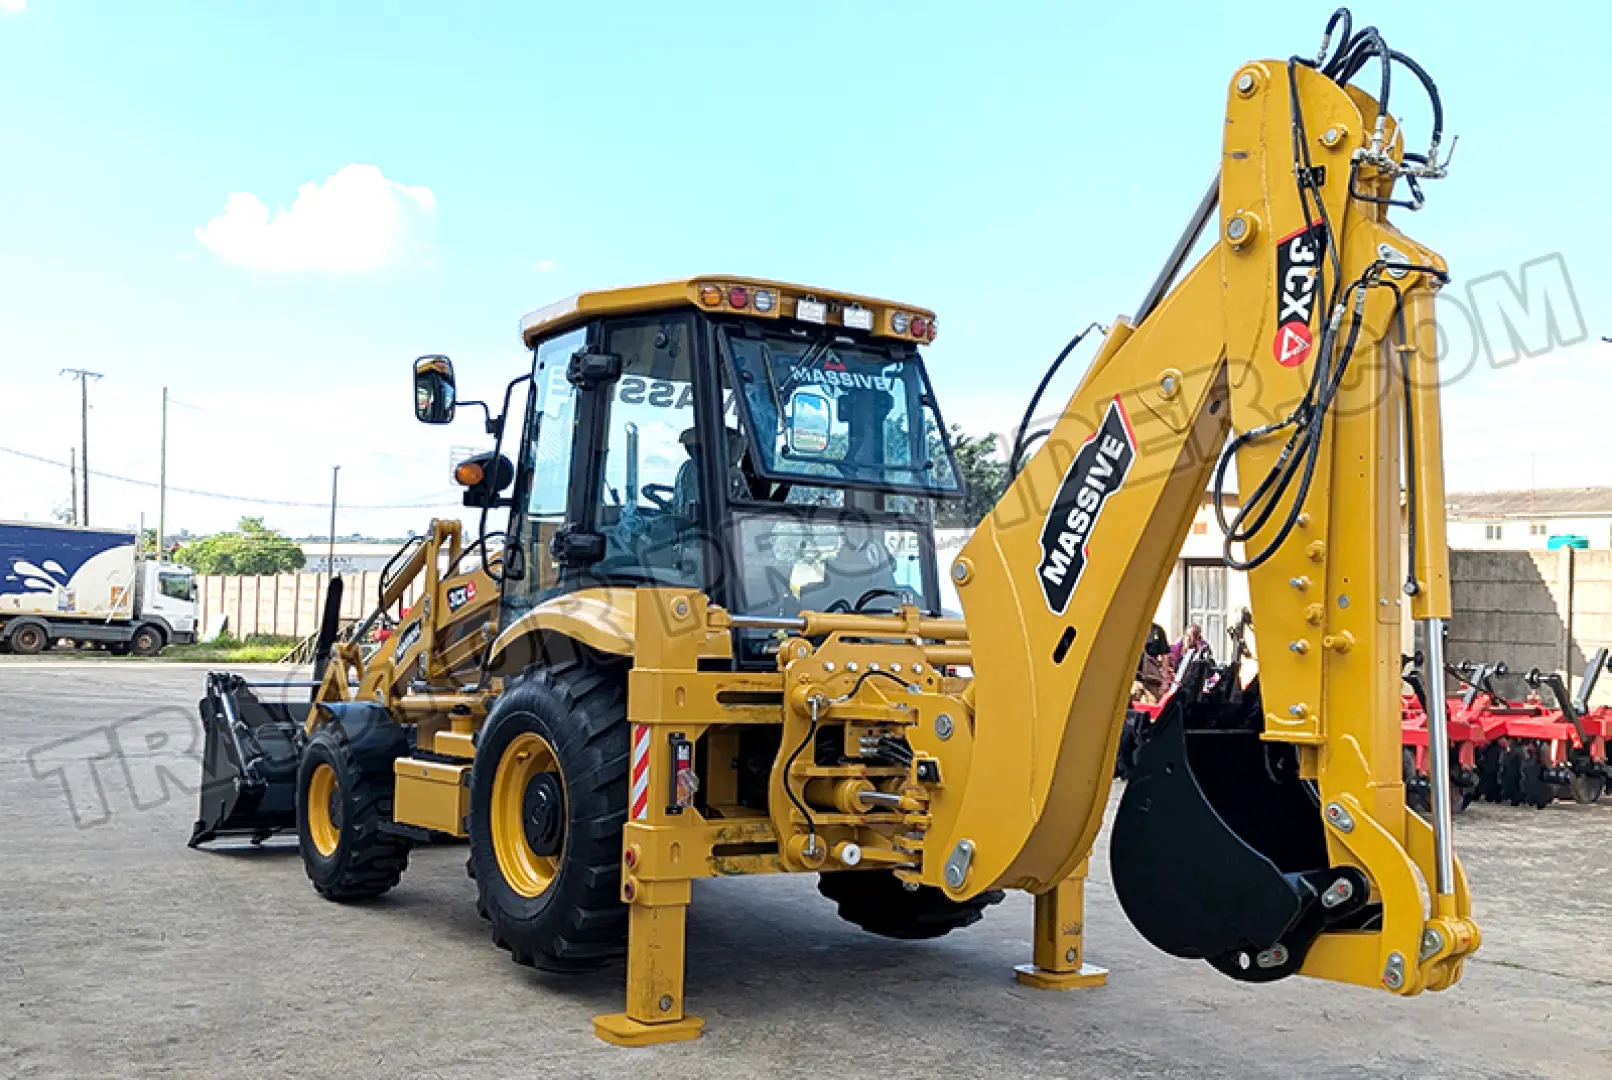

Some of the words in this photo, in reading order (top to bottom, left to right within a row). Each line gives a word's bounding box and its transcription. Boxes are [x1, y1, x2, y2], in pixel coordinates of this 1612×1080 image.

[1280, 237, 1319, 321] 3CX
[789, 364, 892, 391] MASSIVE
[1042, 434, 1125, 586] MASSIVE
